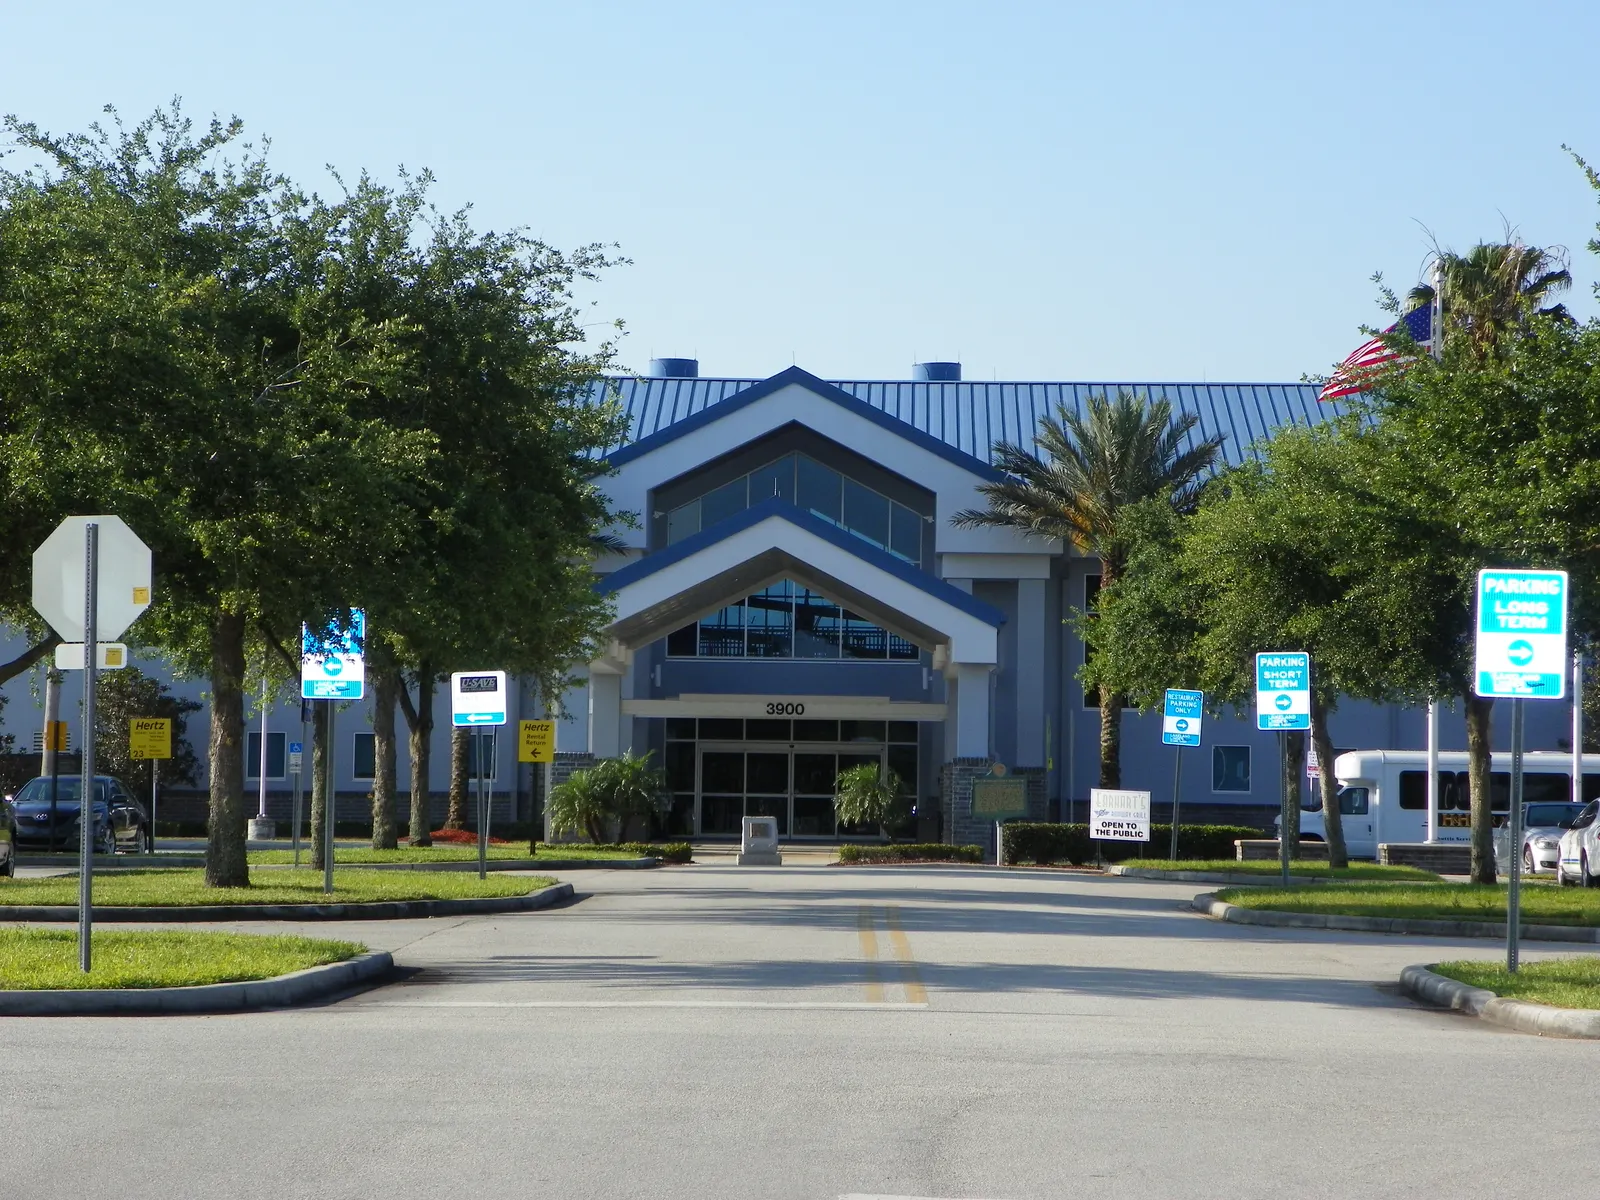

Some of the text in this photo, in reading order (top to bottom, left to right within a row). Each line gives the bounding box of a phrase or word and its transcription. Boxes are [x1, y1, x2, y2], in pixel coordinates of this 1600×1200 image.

[1485, 578, 1560, 595] PARKING
[1495, 600, 1549, 614] LONG
[1497, 616, 1547, 629] TERM
[1260, 657, 1305, 667] PARKING
[1264, 671, 1302, 679] SHORT
[461, 678, 496, 687] U-SAVE
[1269, 680, 1298, 688] TERM
[766, 703, 805, 715] 3900
[136, 722, 165, 730] Hertz
[133, 750, 144, 758] 23
[1101, 821, 1124, 829] OPEN
[1113, 830, 1144, 838] PUBLIC
